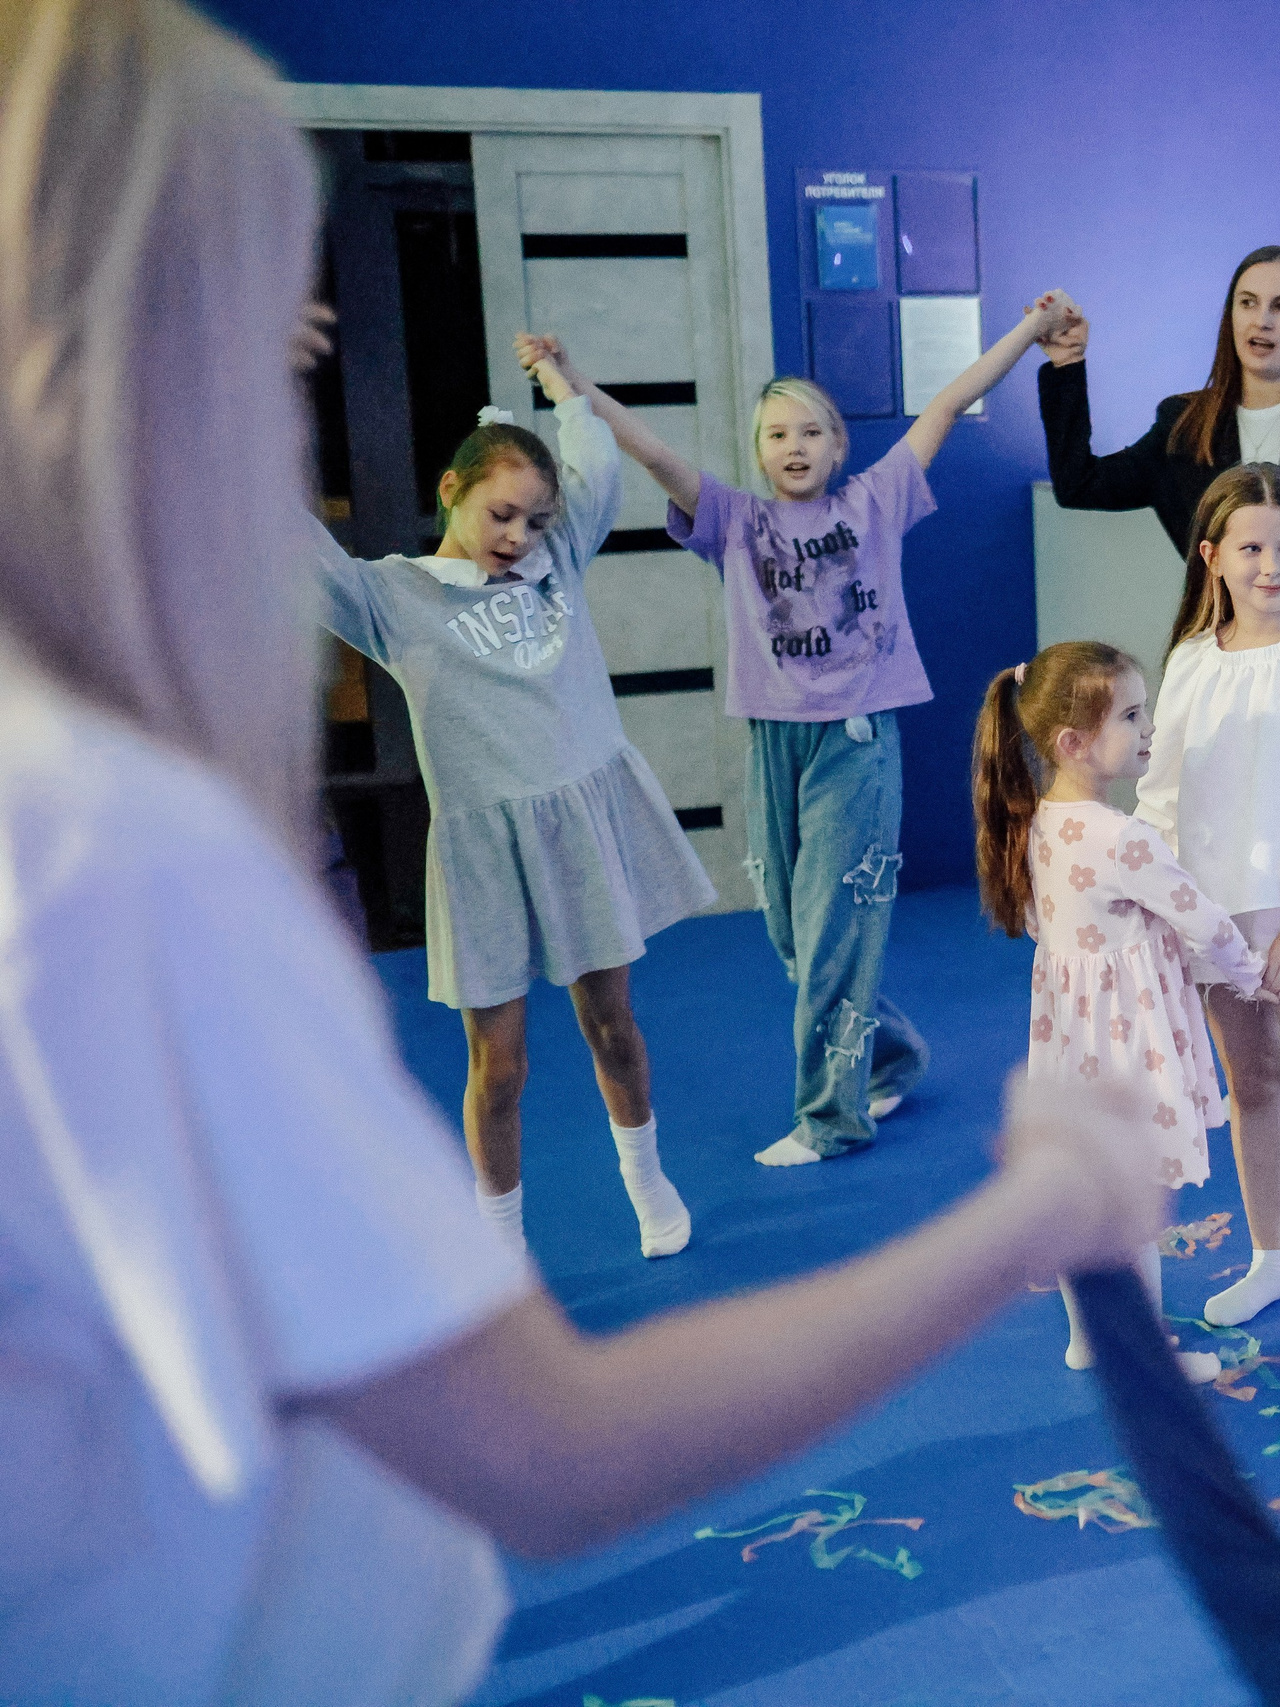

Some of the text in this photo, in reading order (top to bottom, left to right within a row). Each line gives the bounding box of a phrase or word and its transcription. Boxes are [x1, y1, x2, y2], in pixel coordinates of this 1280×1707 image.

[804, 185, 886, 199] ПОТРЕБИТЕЛЯ
[823, 172, 867, 185] УГОЛОК
[792, 520, 860, 563] look
[849, 579, 879, 613] be
[770, 625, 833, 658] cold
